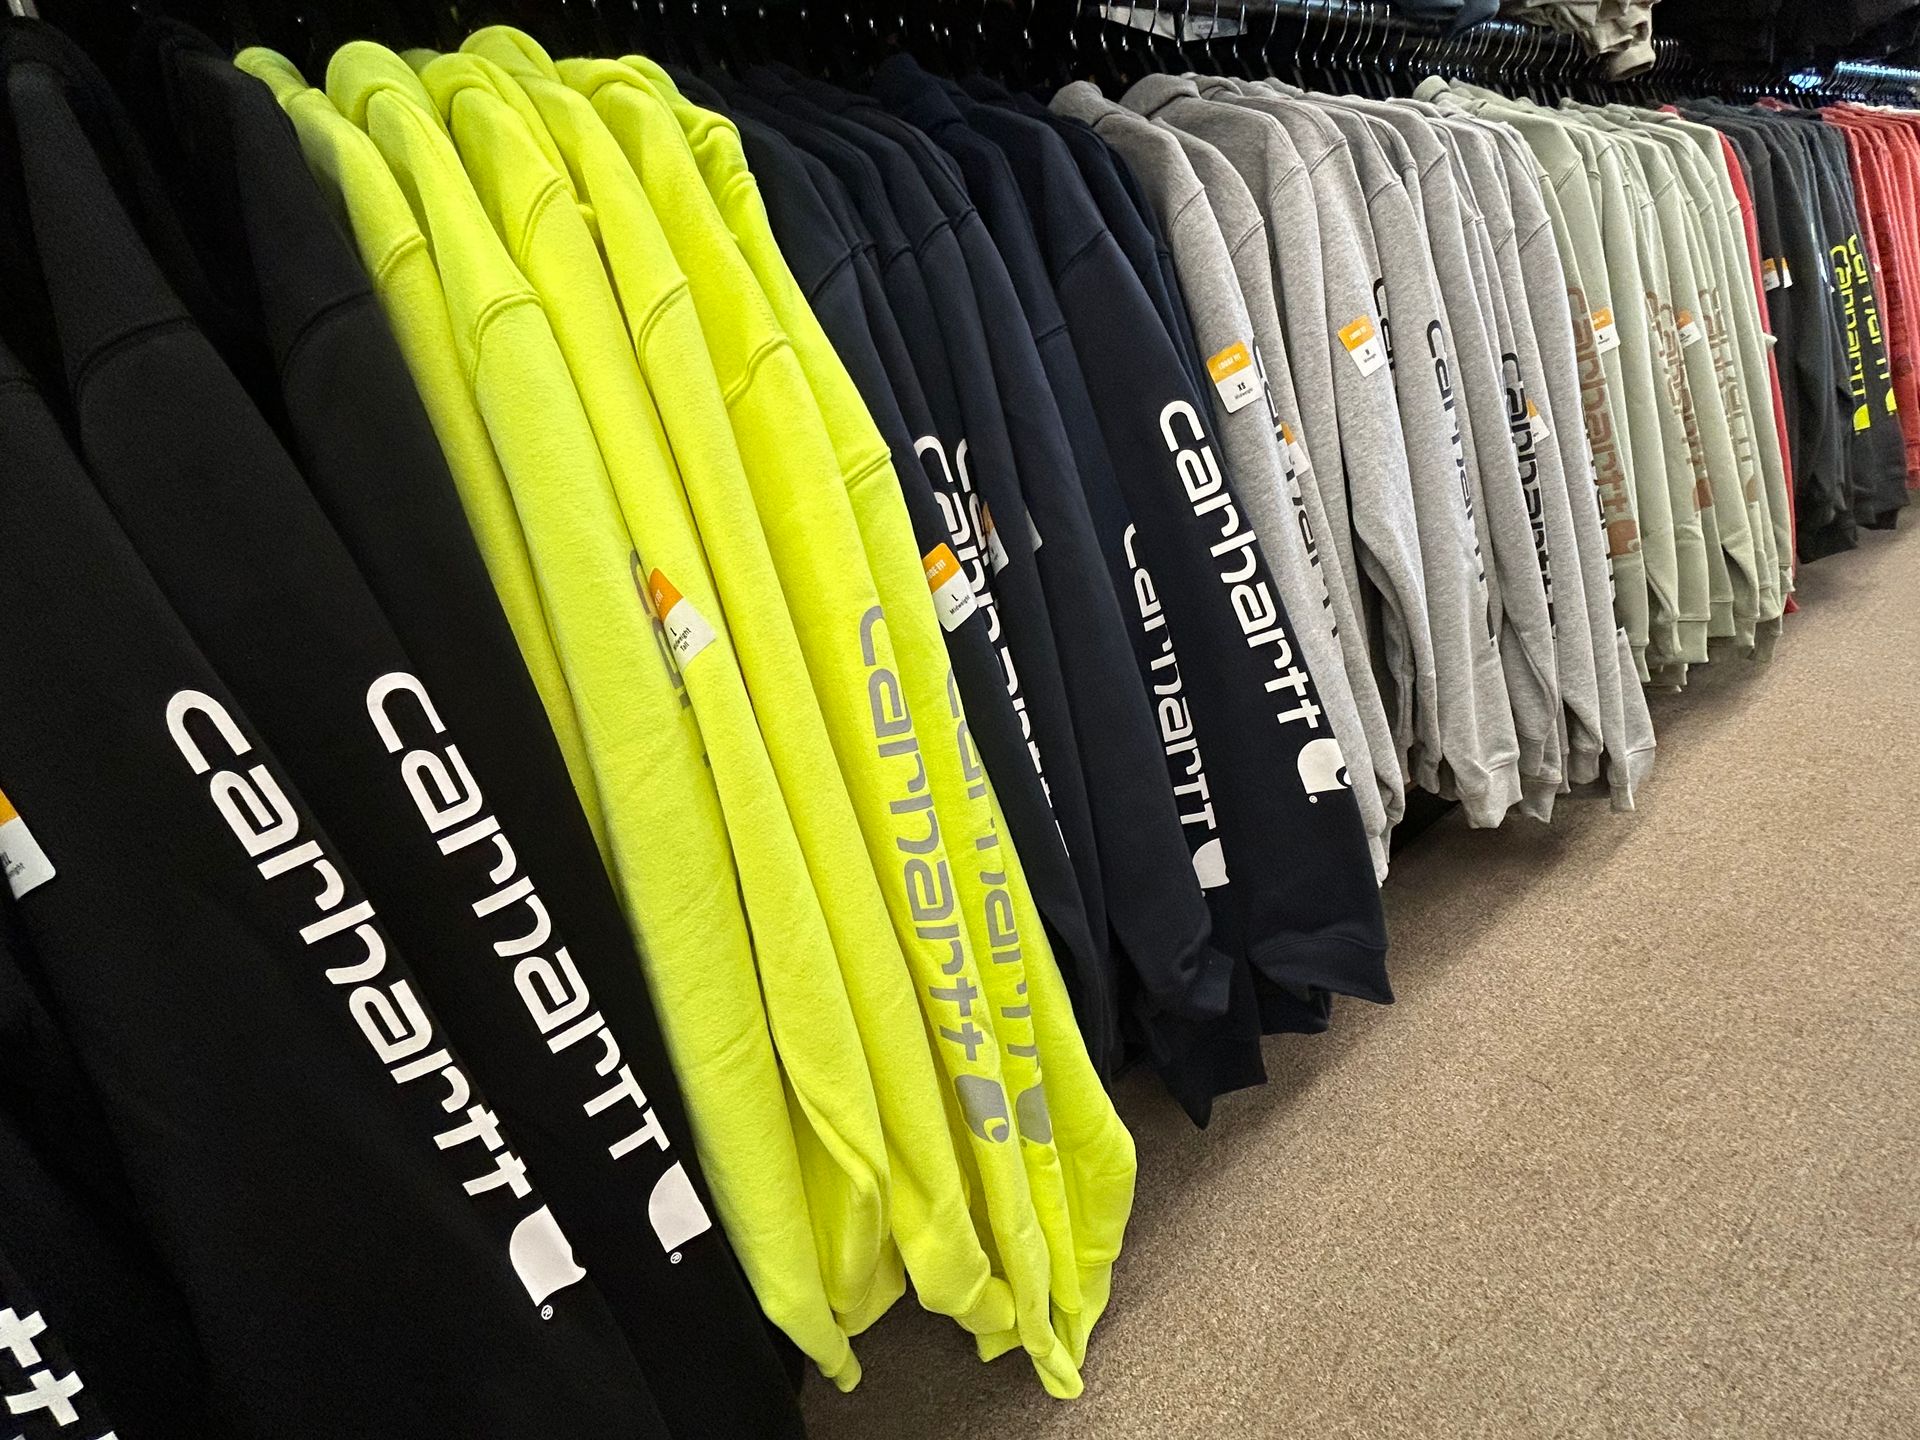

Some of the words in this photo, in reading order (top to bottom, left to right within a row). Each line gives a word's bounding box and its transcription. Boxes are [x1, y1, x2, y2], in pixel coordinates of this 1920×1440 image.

[1237, 381, 1247, 391] XS
[679, 641, 690, 652] Tall
[949, 595, 971, 615] Midweight
[951, 594, 959, 602] L
[1159, 399, 1322, 729] Carhartt
[366, 671, 671, 1161] Carhartt
[859, 605, 984, 1062] Carhartt
[166, 689, 533, 1199] Carhartt
